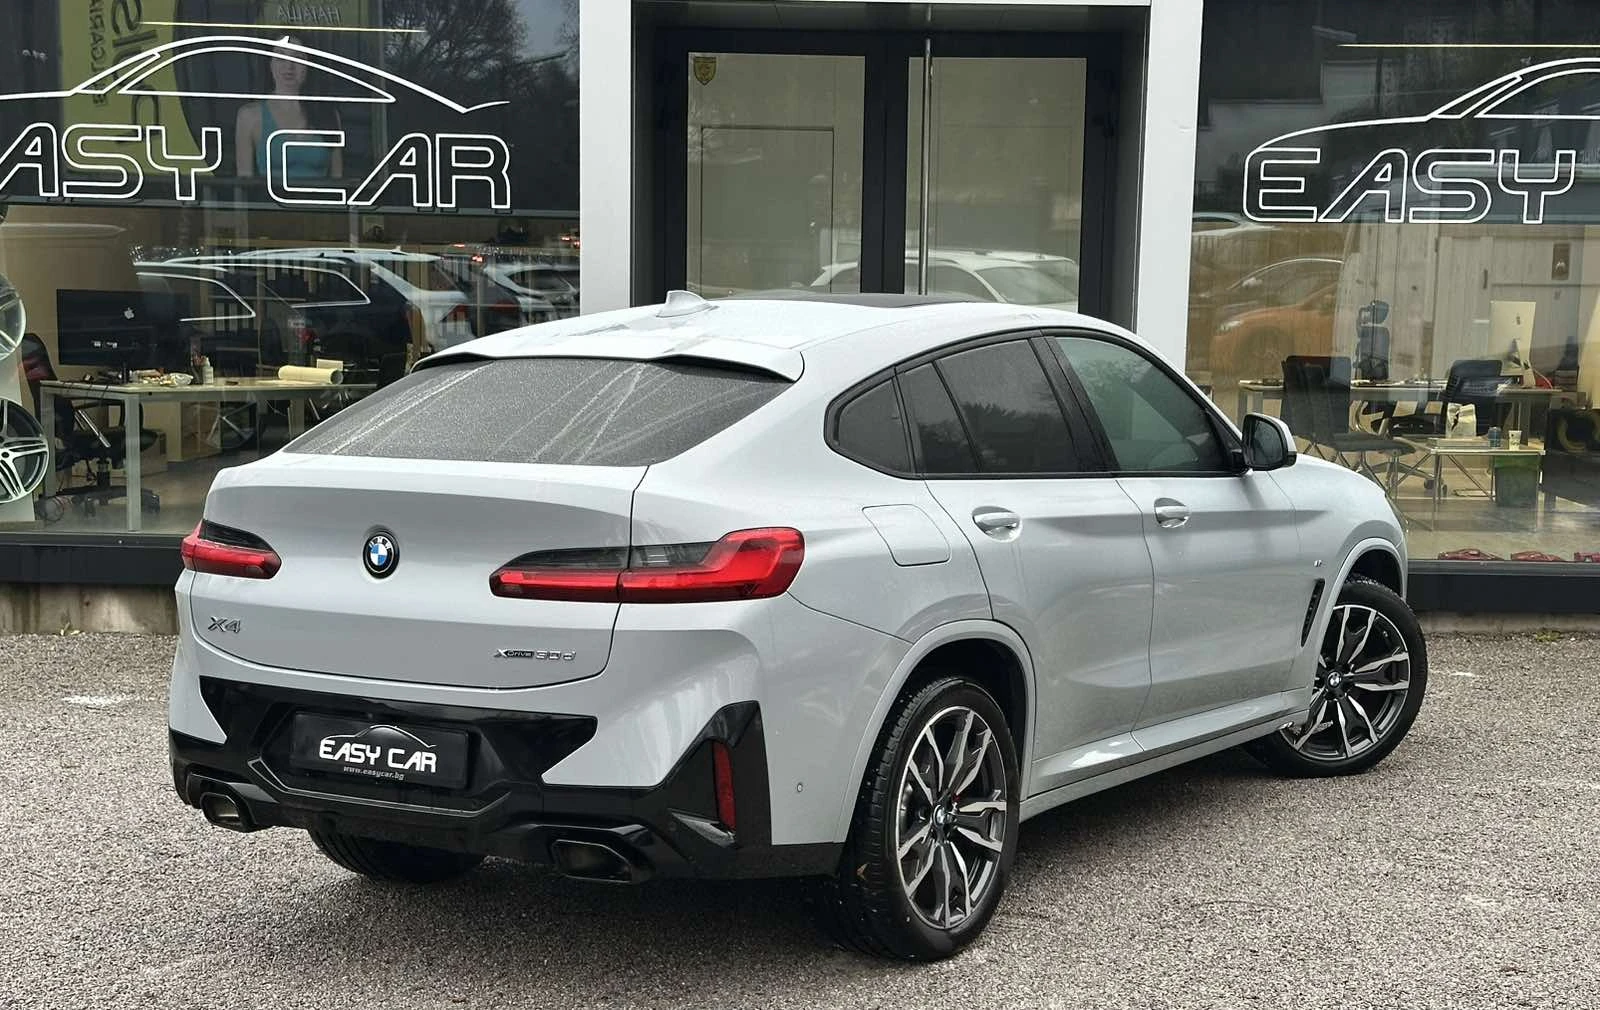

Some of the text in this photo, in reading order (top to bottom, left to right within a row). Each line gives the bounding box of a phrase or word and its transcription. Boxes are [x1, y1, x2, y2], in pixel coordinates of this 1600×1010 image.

[266, 130, 511, 209] CAR
[1243, 148, 1576, 224] EASY
[207, 616, 241, 633] X4
[319, 739, 437, 773] EASY CAR
[343, 766, 405, 780] www.easycar.bg
